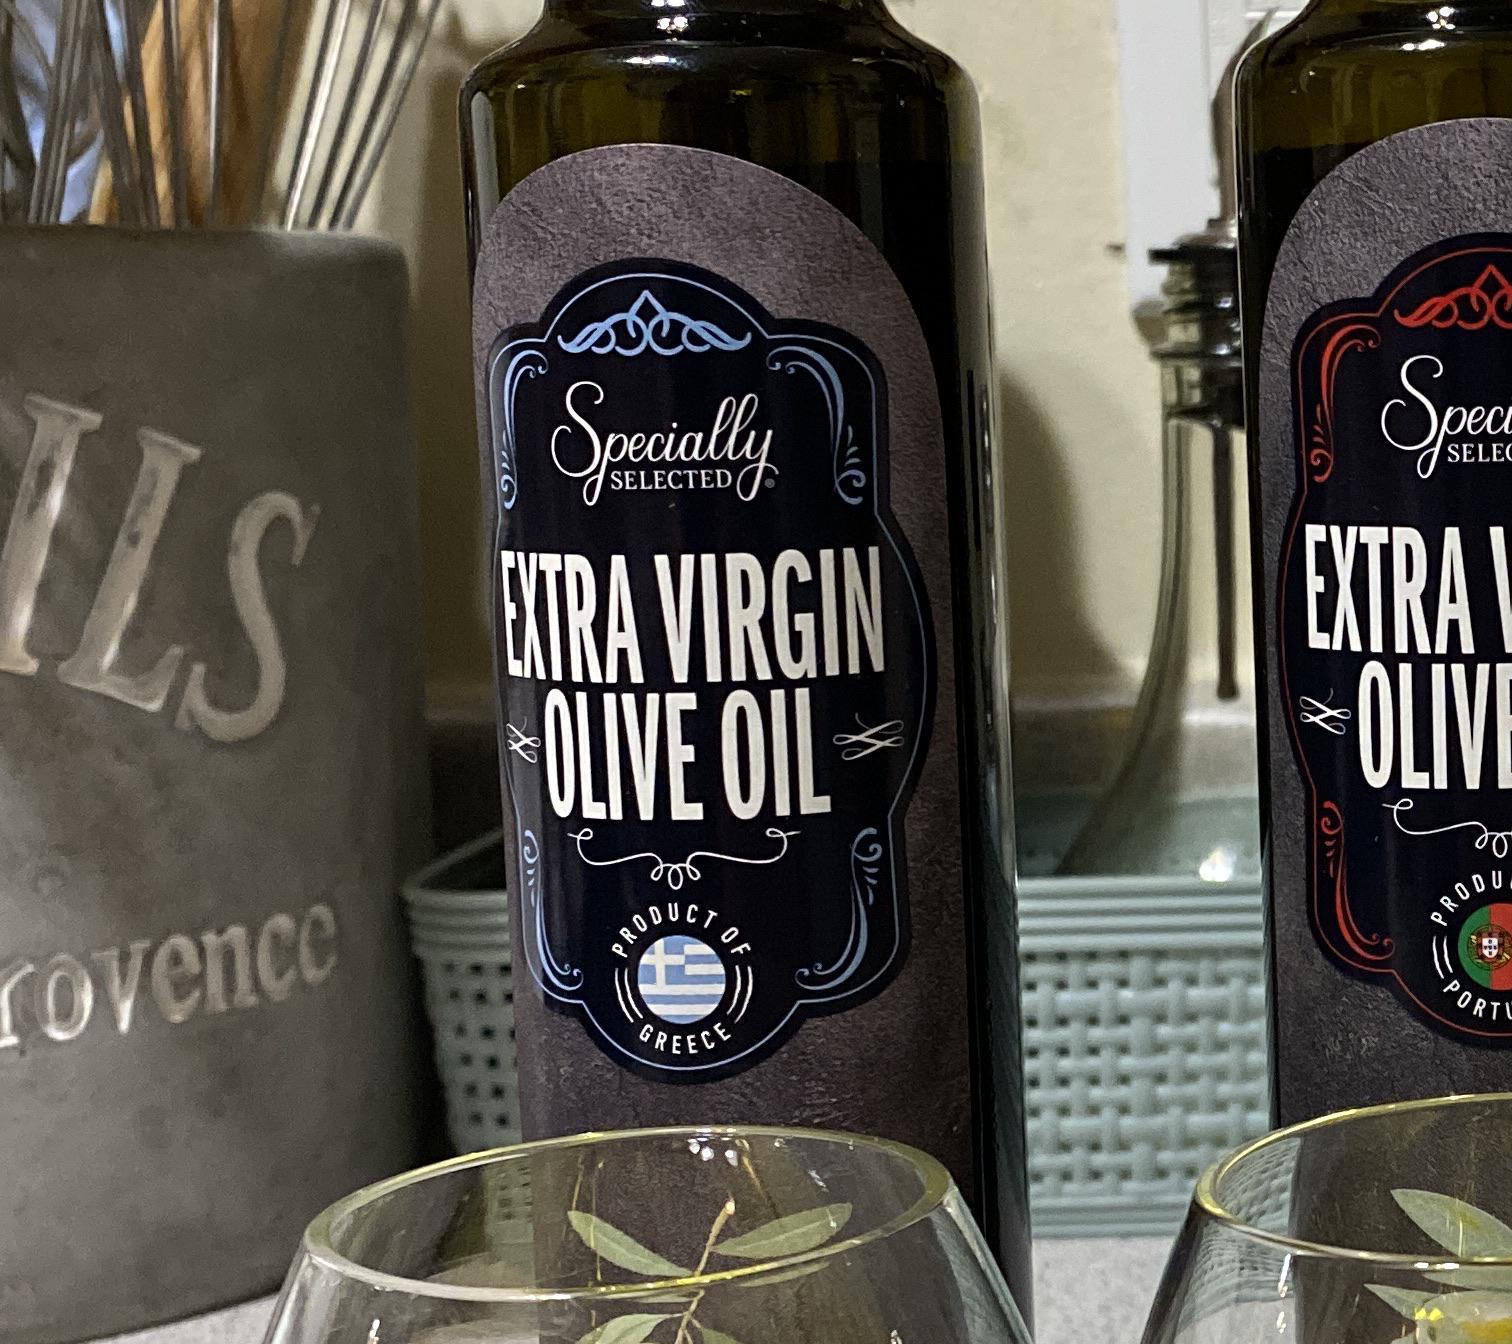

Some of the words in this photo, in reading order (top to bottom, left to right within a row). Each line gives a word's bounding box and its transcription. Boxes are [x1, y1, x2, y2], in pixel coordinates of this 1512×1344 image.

[551, 381, 779, 507] Specially
[611, 469, 732, 491] SELECTED
[501, 550, 649, 683] EXTRA
[654, 546, 885, 683] VIRGIN
[1304, 524, 1476, 654] EXTRA
[544, 690, 704, 821] OLIVE
[721, 688, 832, 819] OIL
[612, 903, 718, 959] PRODUCT
[719, 925, 752, 958] OF
[638, 1022, 733, 1056] GREECE
